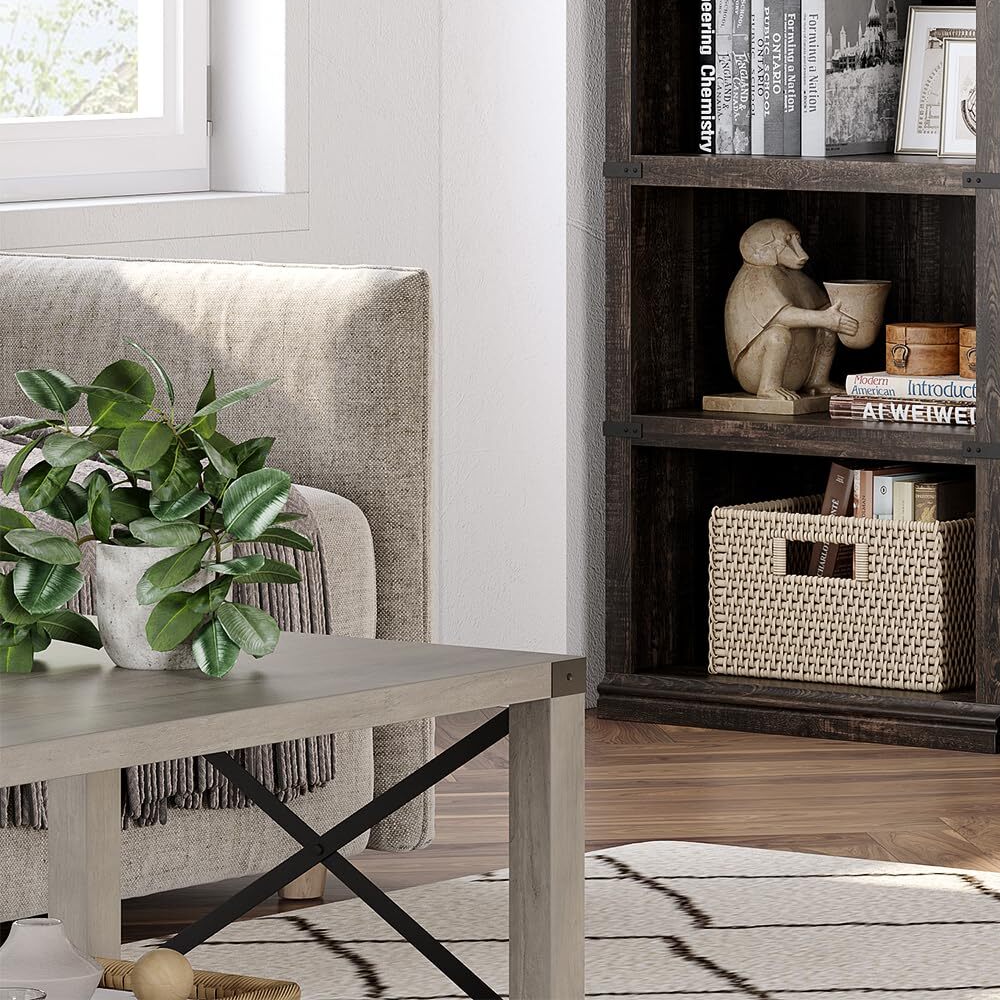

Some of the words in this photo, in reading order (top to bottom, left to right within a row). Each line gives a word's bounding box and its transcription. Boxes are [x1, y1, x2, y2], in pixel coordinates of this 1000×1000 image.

[737, 0, 747, 29] SCHOOL
[787, 13, 797, 63] Forming
[807, 13, 819, 63] Forming
[733, 51, 749, 103] ENGLAND
[772, 32, 782, 95] ONTARIO
[699, 64, 715, 154] Chemistry
[788, 75, 797, 113] Nation
[808, 75, 819, 113] Nation
[851, 385, 896, 397] American
[854, 375, 889, 386] Modern
[863, 402, 885, 420] AI
